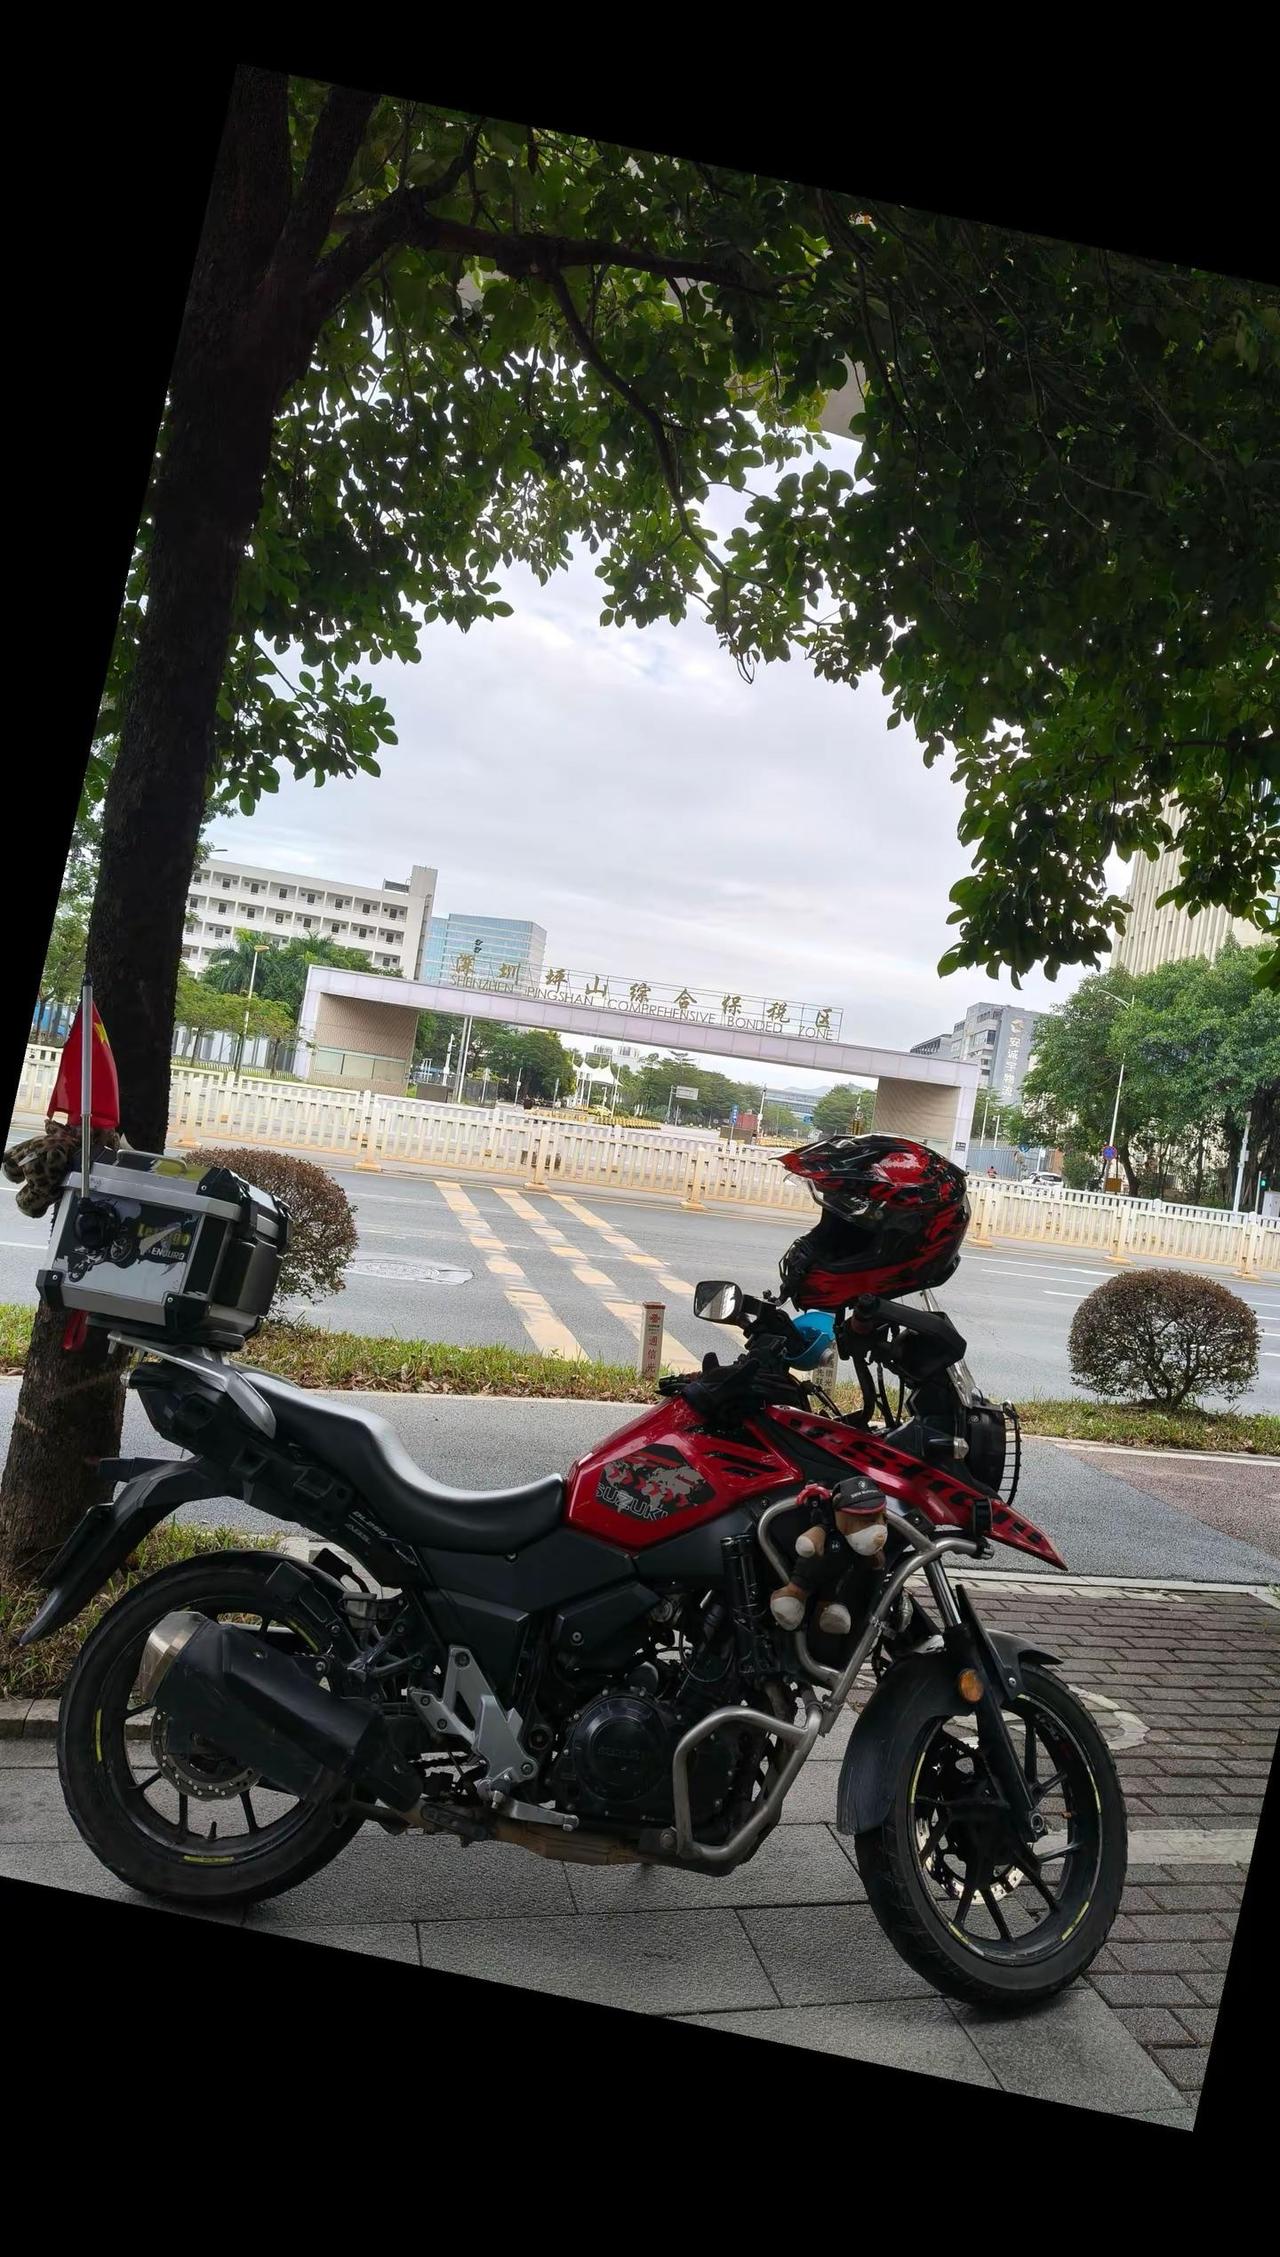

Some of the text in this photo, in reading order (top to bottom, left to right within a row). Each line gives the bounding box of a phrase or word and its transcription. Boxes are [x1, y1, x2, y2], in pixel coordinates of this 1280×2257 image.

[450, 974, 833, 1041] SHENZHEN PINGSHAN COMPREHENSIVE BONDED ZONE
[454, 952, 833, 1030] 深圳坪山综合保税区
[595, 1481, 669, 1521] SUZUKI
